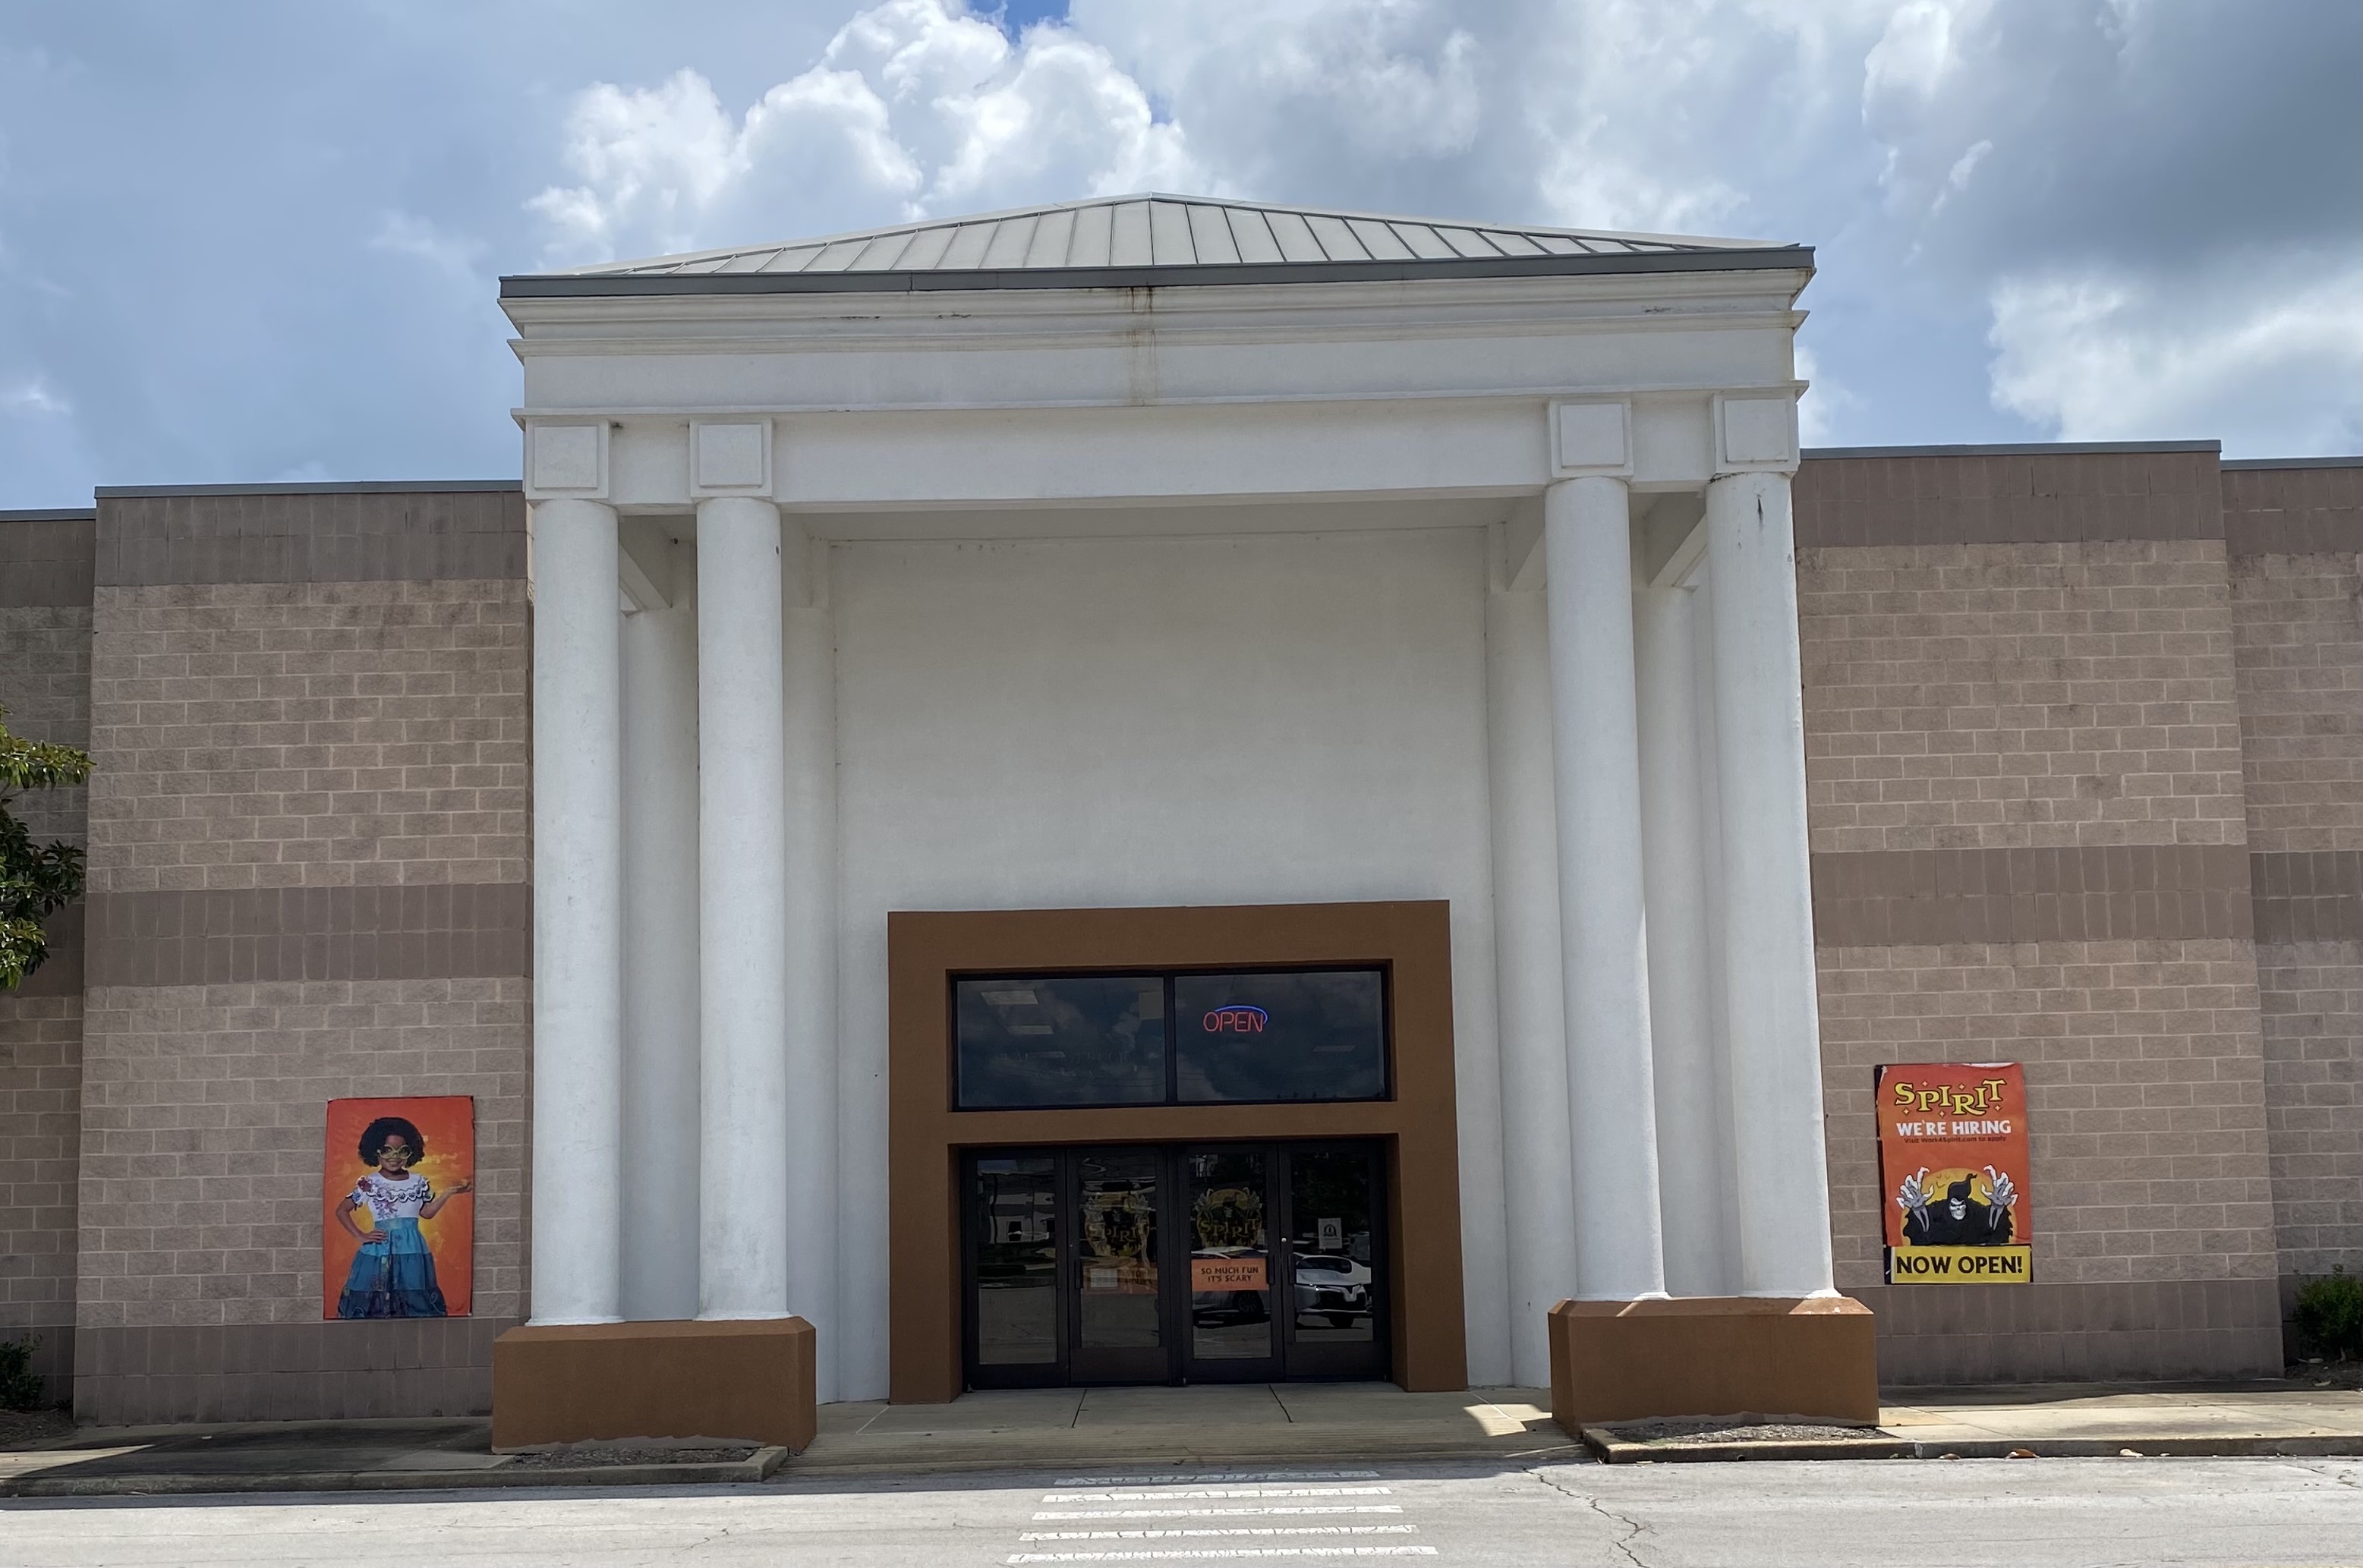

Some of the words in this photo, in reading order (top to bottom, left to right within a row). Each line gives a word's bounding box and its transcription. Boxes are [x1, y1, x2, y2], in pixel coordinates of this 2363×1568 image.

[1203, 1012, 1264, 1032] OPEN
[1894, 1078, 2007, 1116] SPIRIT
[1896, 1119, 1947, 1136] WE'RE
[1952, 1119, 2012, 1135] HIRING
[1200, 1218, 1259, 1238] SPIRIT
[1896, 1256, 1951, 1274] NOW
[1958, 1255, 2023, 1274] OPEN!
